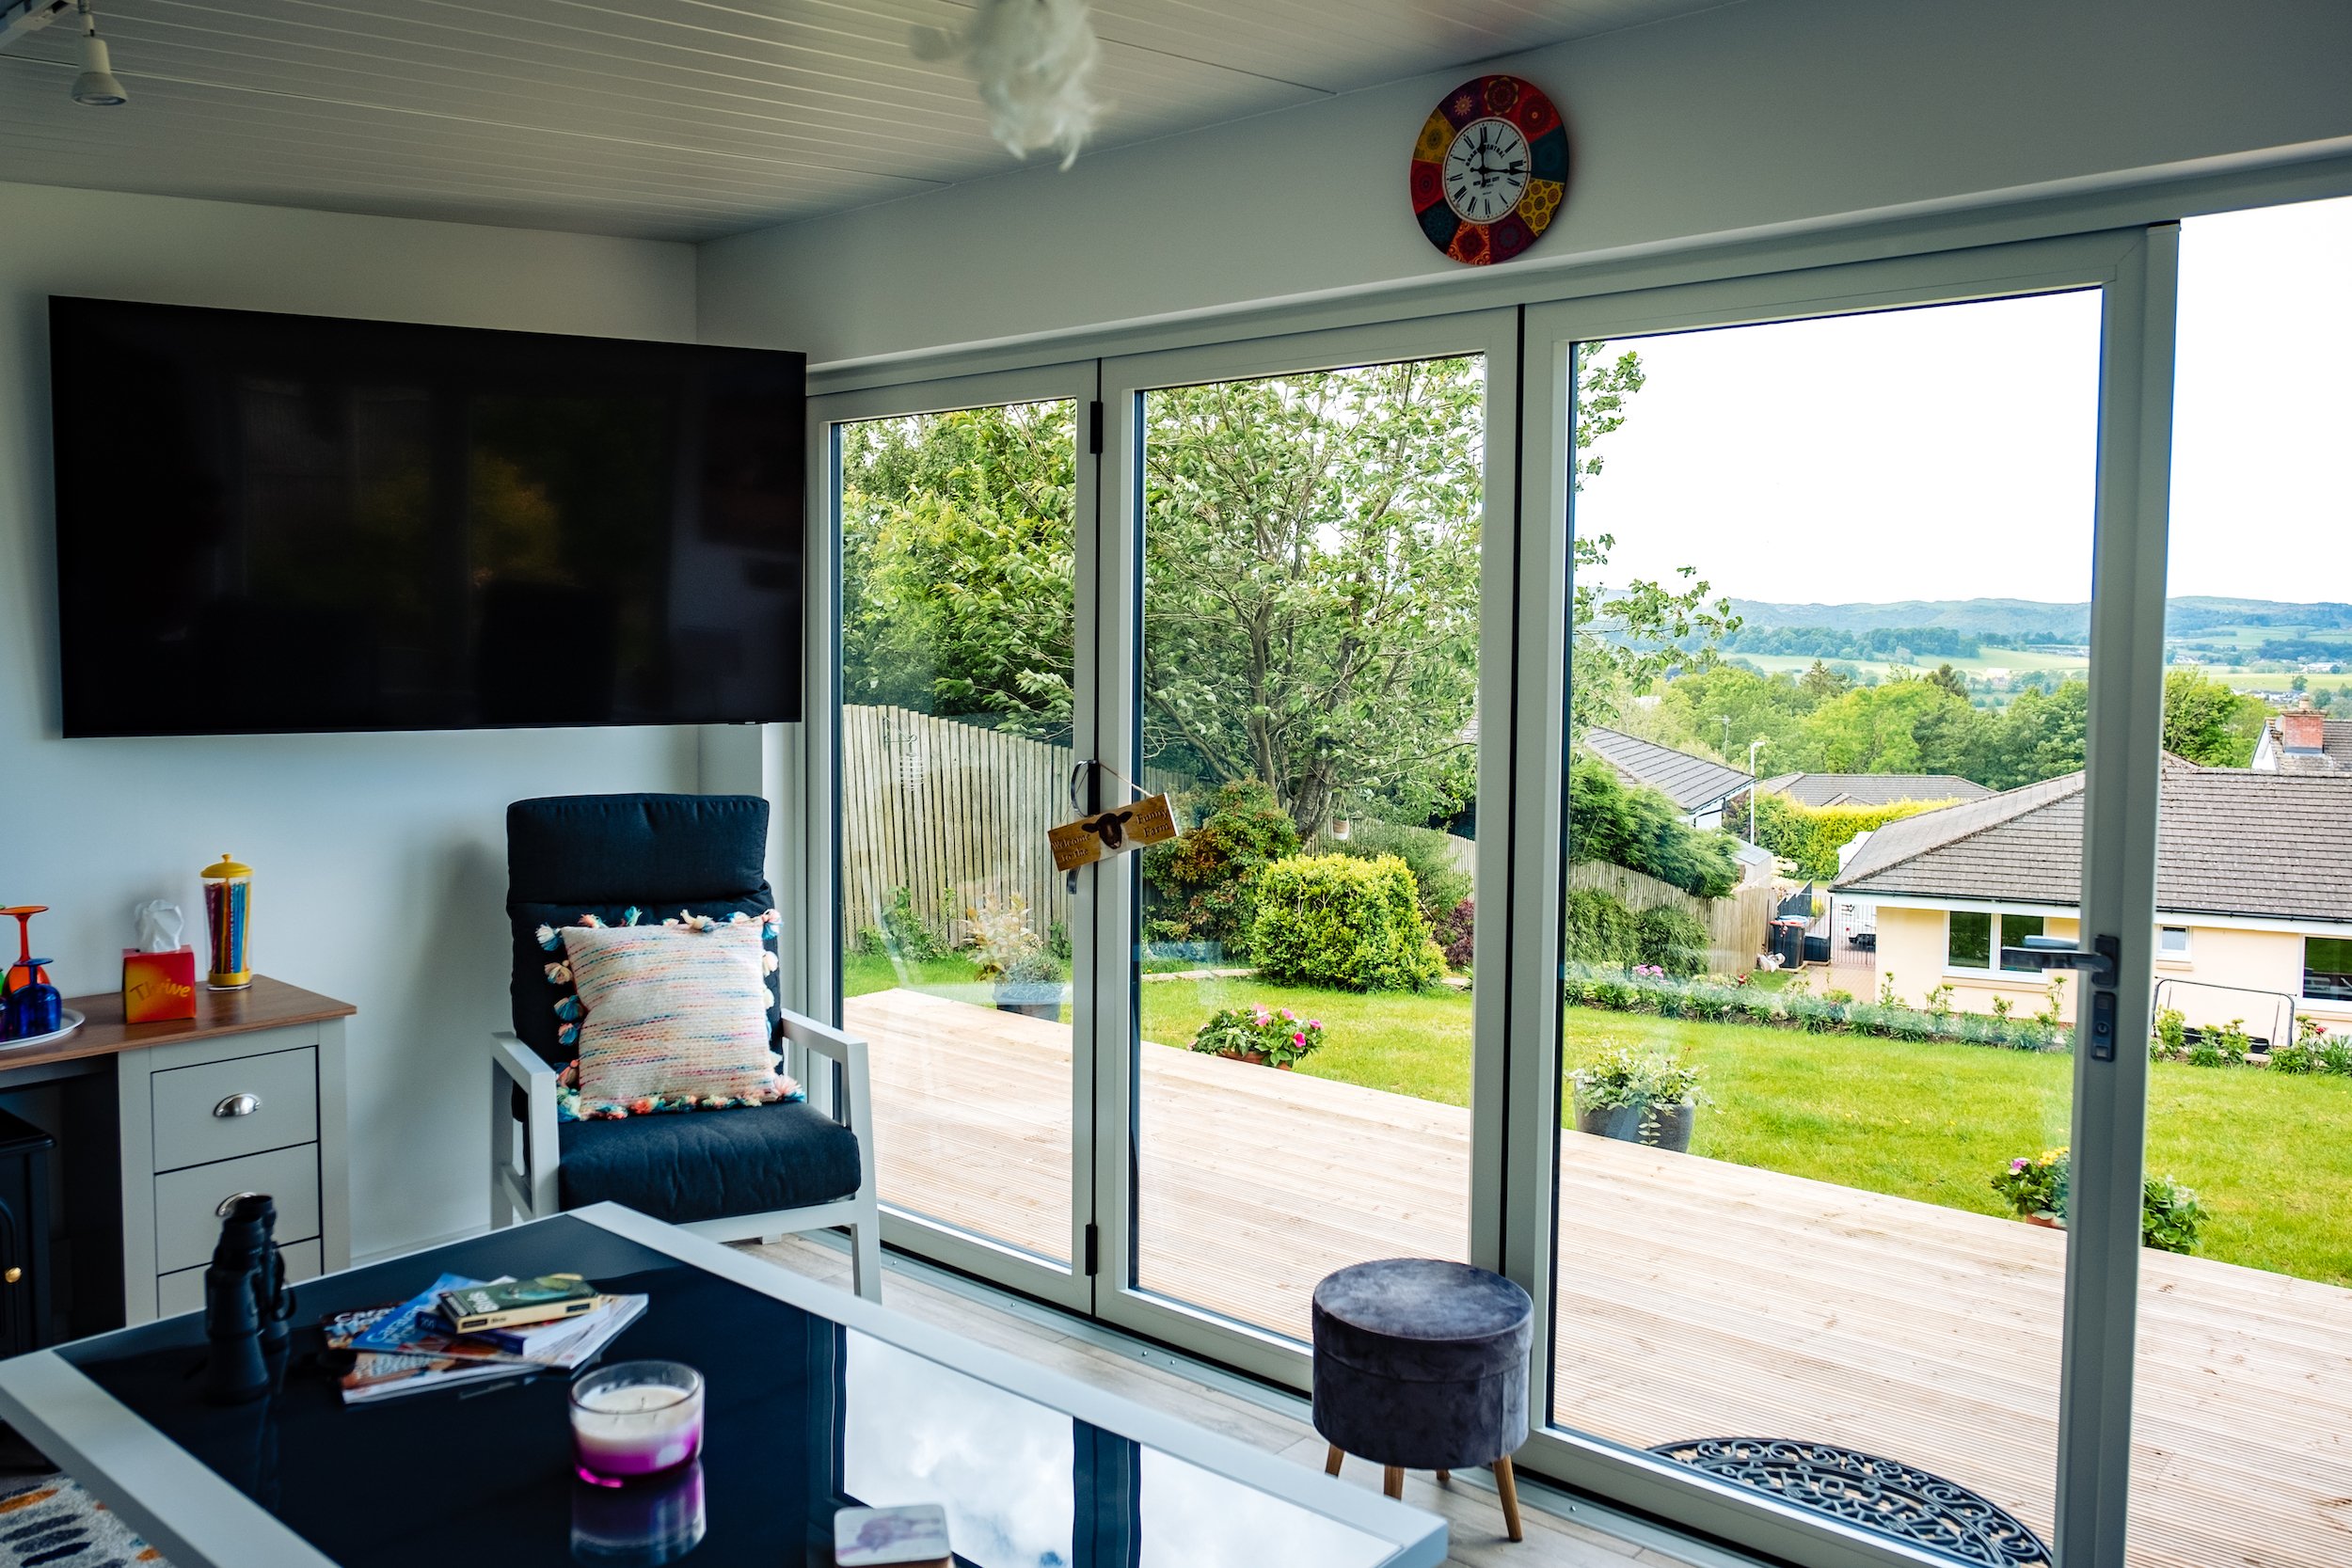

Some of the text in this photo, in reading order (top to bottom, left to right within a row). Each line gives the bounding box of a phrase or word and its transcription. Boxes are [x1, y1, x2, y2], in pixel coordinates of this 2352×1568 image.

[1136, 808, 1168, 824] Funny
[1143, 822, 1168, 837] Farm
[1052, 832, 1090, 850] Welcome
[1061, 847, 1089, 862] to the
[130, 978, 191, 1001] Thrive
[1748, 1469, 1962, 1543] WELCOME
